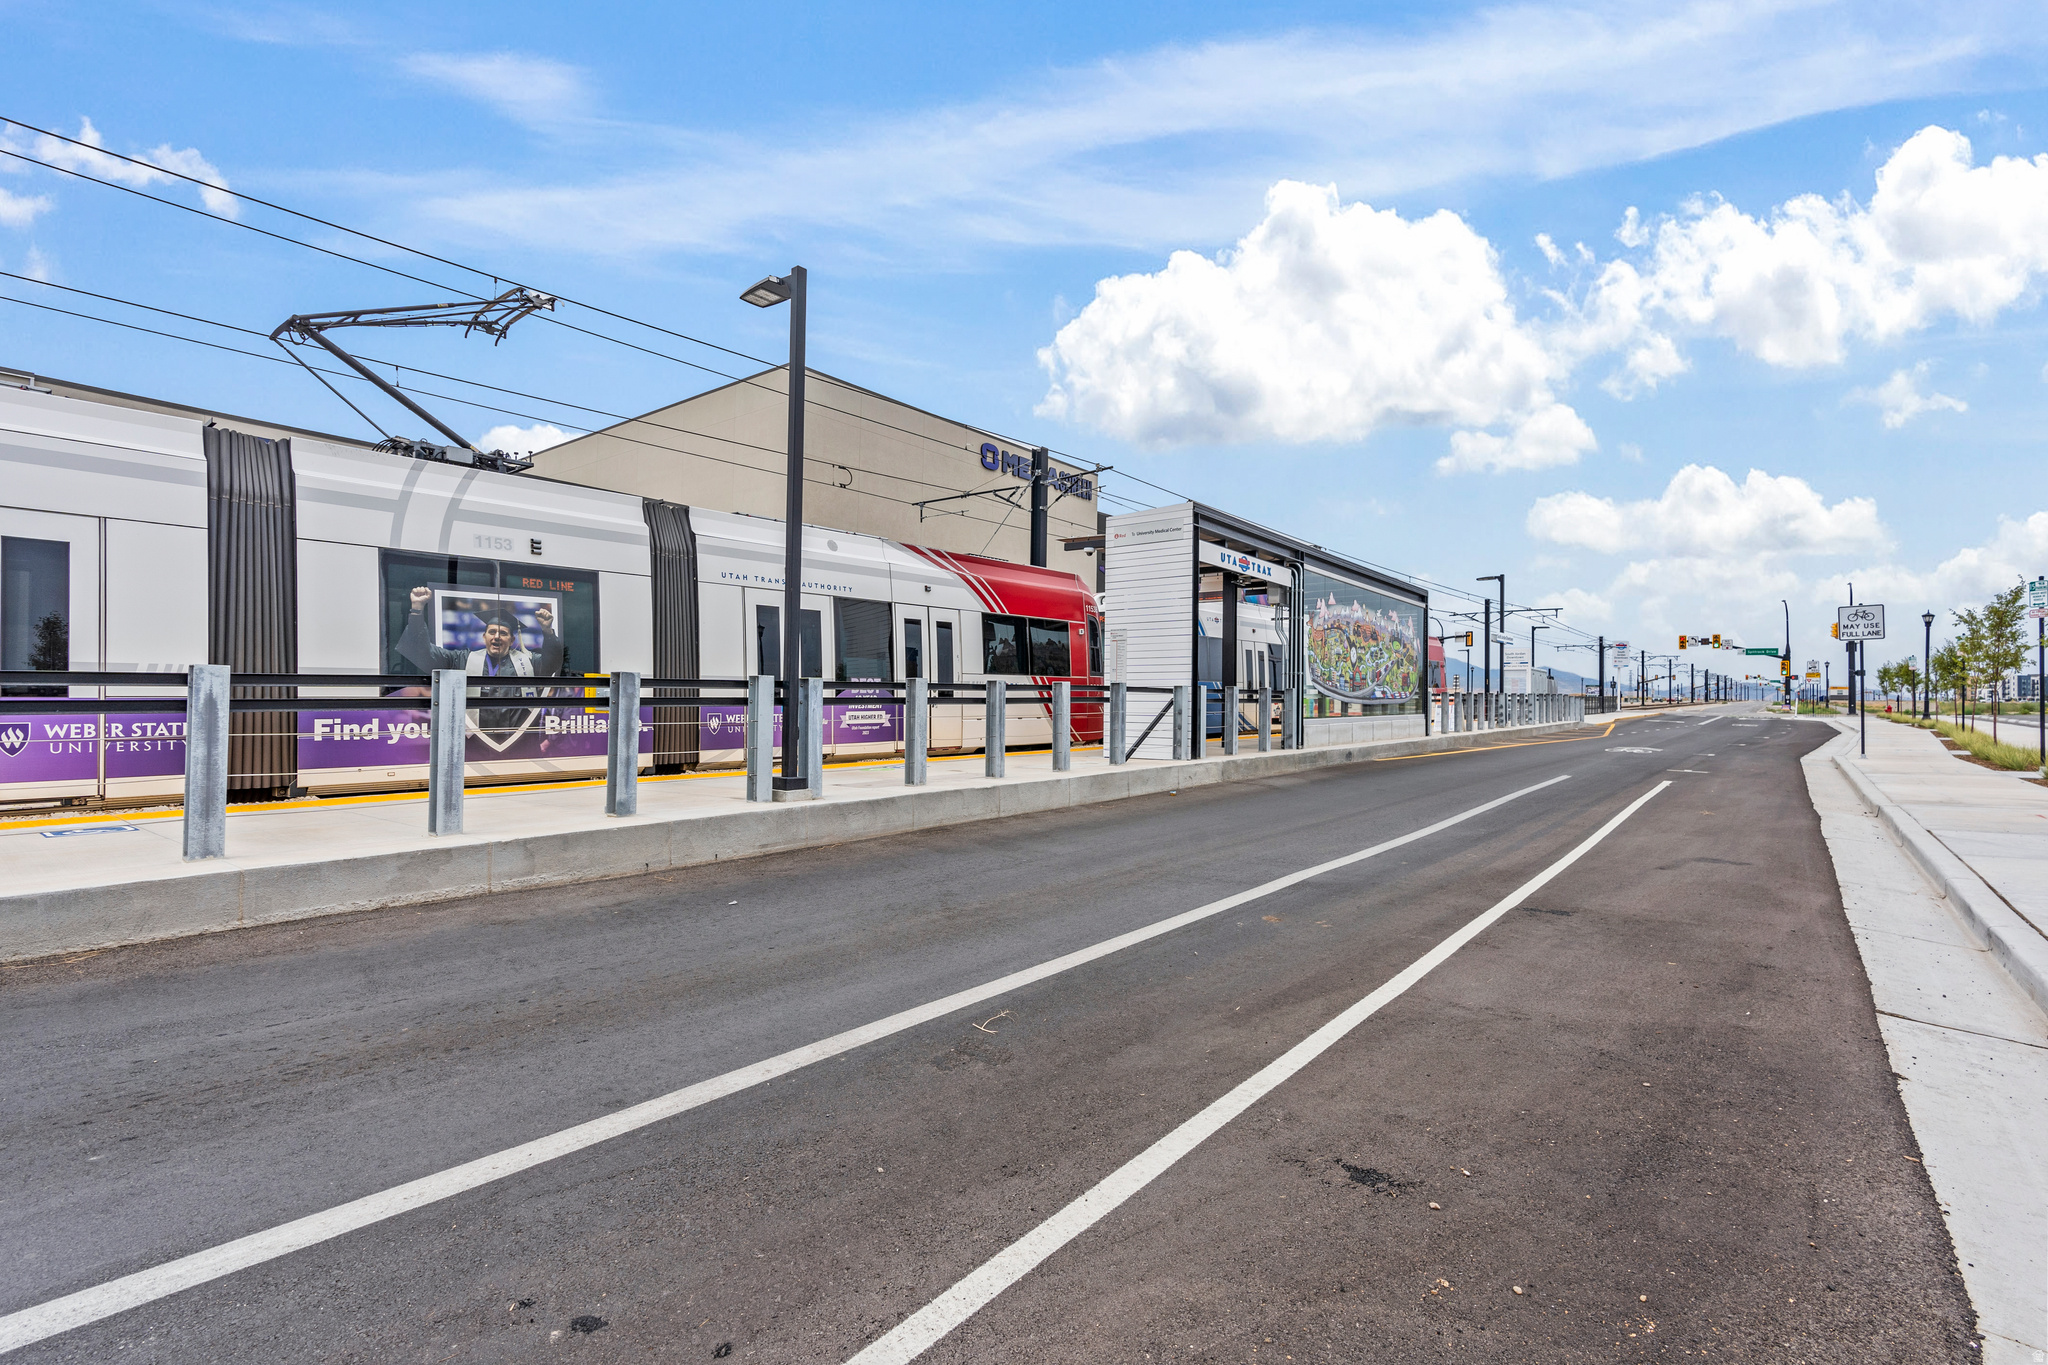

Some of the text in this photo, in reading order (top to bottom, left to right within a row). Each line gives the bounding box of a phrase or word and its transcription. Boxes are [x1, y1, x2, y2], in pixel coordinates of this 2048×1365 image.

[475, 535, 513, 551] 1153
[1220, 552, 1272, 577] UTA TRAX
[522, 577, 575, 592] RED LINE
[721, 571, 748, 581] UTAH
[801, 581, 853, 593] AUTHORITY
[314, 718, 378, 741] Find
